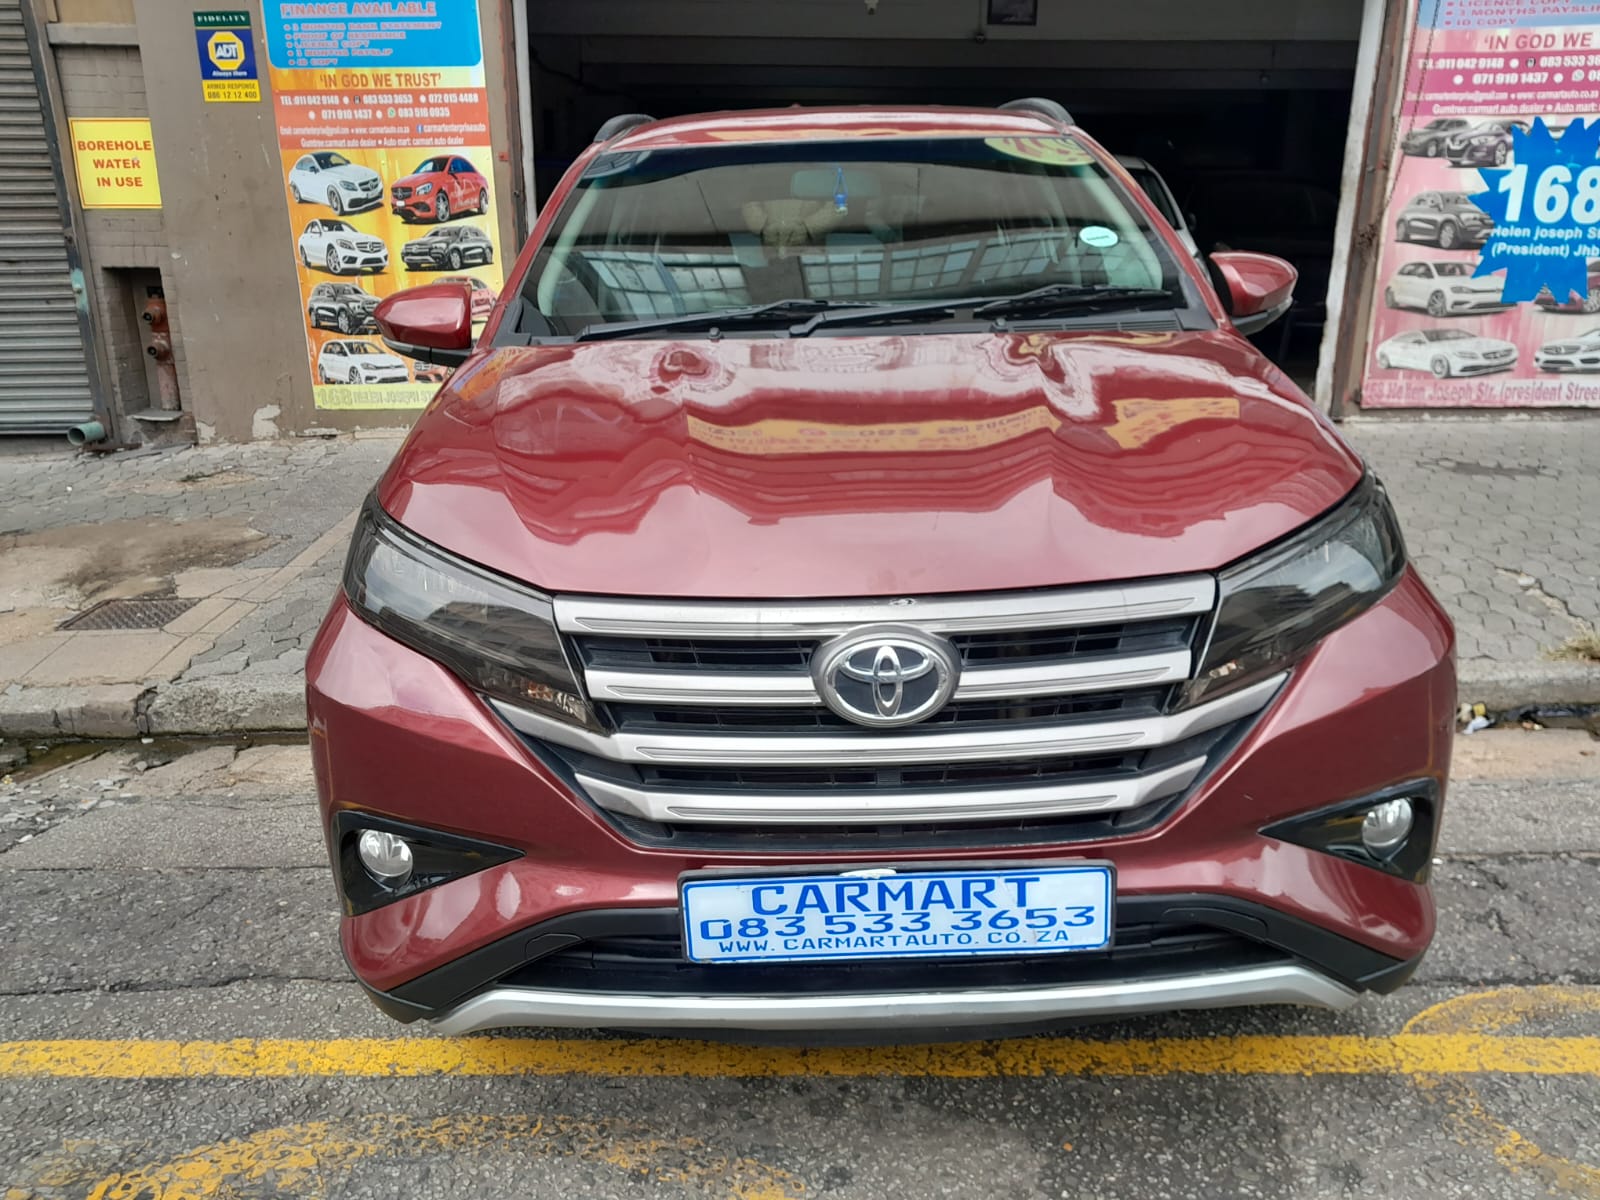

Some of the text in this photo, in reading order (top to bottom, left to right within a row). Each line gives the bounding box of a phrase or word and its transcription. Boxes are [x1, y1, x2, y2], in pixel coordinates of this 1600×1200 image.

[280, 2, 436, 17] FINANCE AVAILABLE
[1471, 8, 1537, 16] MONTHS
[197, 14, 246, 22] FIDELITY
[1477, 18, 1517, 26] COPY
[1516, 34, 1556, 49] GOD
[1563, 32, 1594, 48] WE
[216, 43, 237, 58] ADT
[342, 74, 369, 87] GOD
[372, 74, 392, 87] WE
[77, 140, 152, 151] BOREHOLE
[93, 158, 141, 169] WATER
[97, 176, 143, 187] IN USE
[1498, 163, 1600, 225] 168
[1491, 242, 1570, 258] (President)
[1566, 382, 1600, 400] Stree
[752, 876, 1040, 916] CARMART
[699, 905, 1095, 940] 083 533 3653
